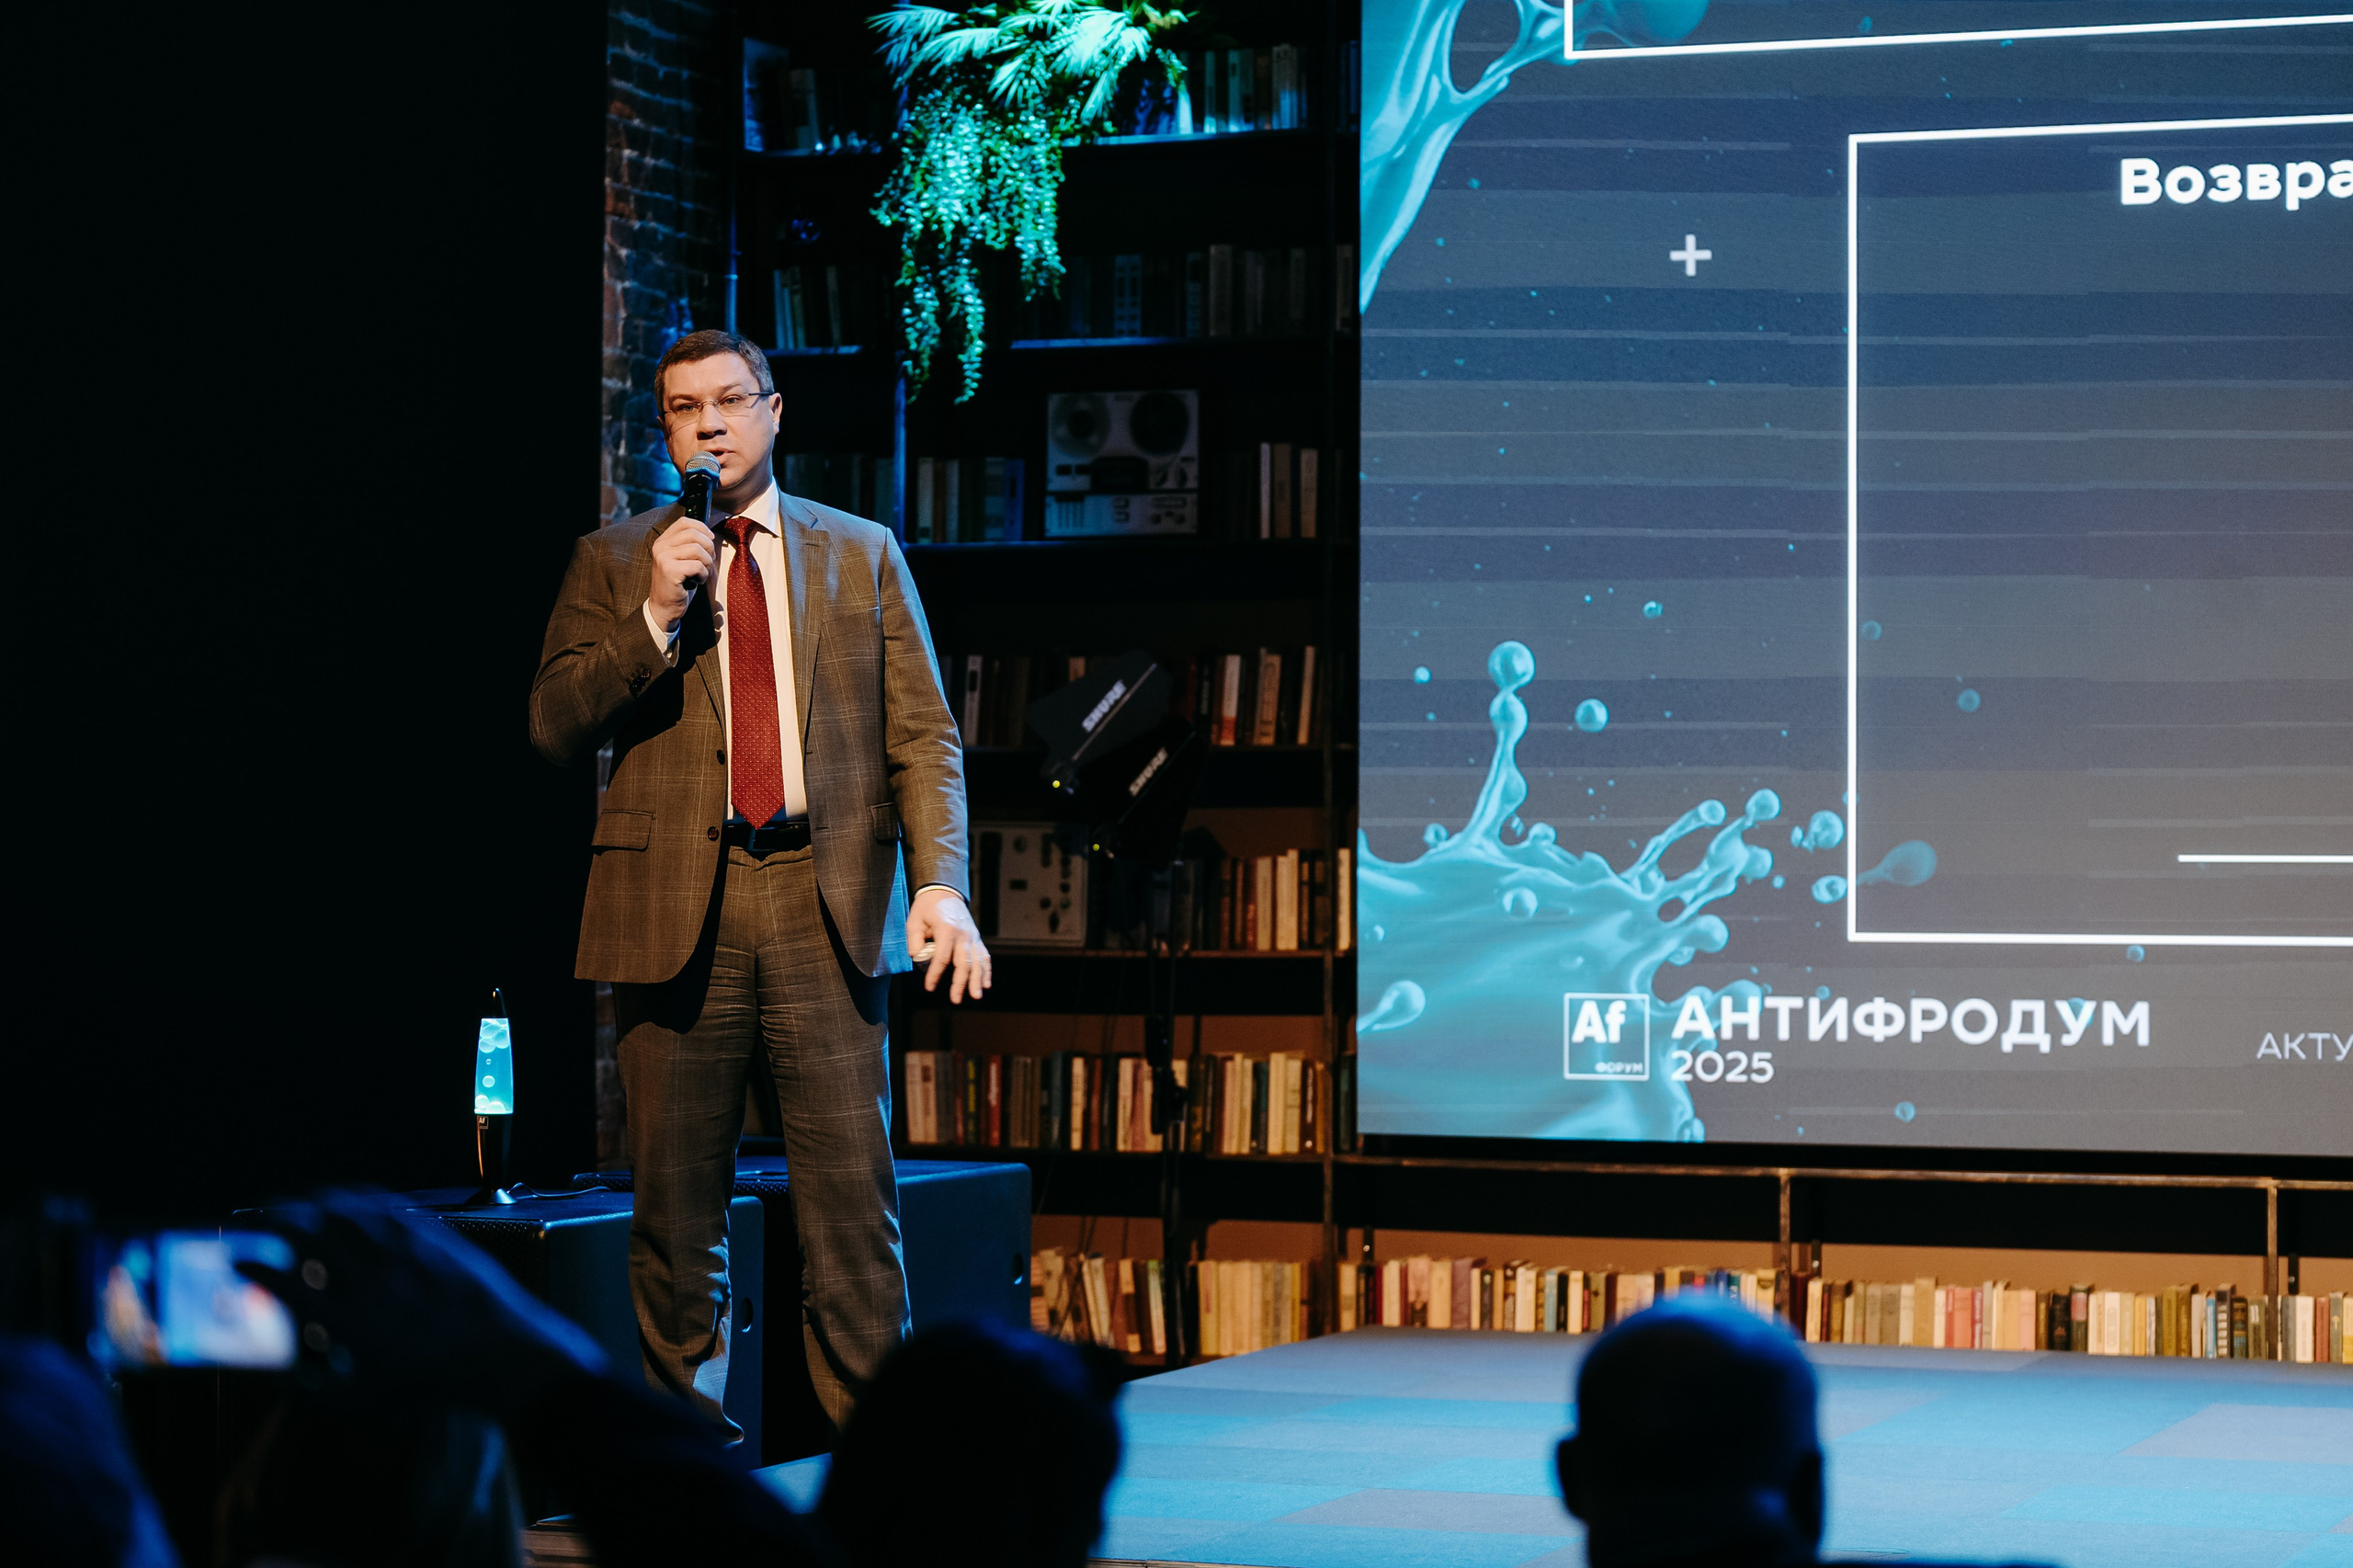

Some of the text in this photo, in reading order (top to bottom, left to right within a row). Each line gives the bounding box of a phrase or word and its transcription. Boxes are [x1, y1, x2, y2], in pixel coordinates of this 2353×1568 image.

[2120, 157, 2353, 211] Возвра
[1571, 999, 1627, 1044] Af
[1671, 994, 2151, 1053] АНТИФРОДУМ
[2256, 1031, 2353, 1062] АКТУ
[1594, 1061, 1643, 1074] ФОРУМ
[1671, 1049, 1775, 1085] 2025
